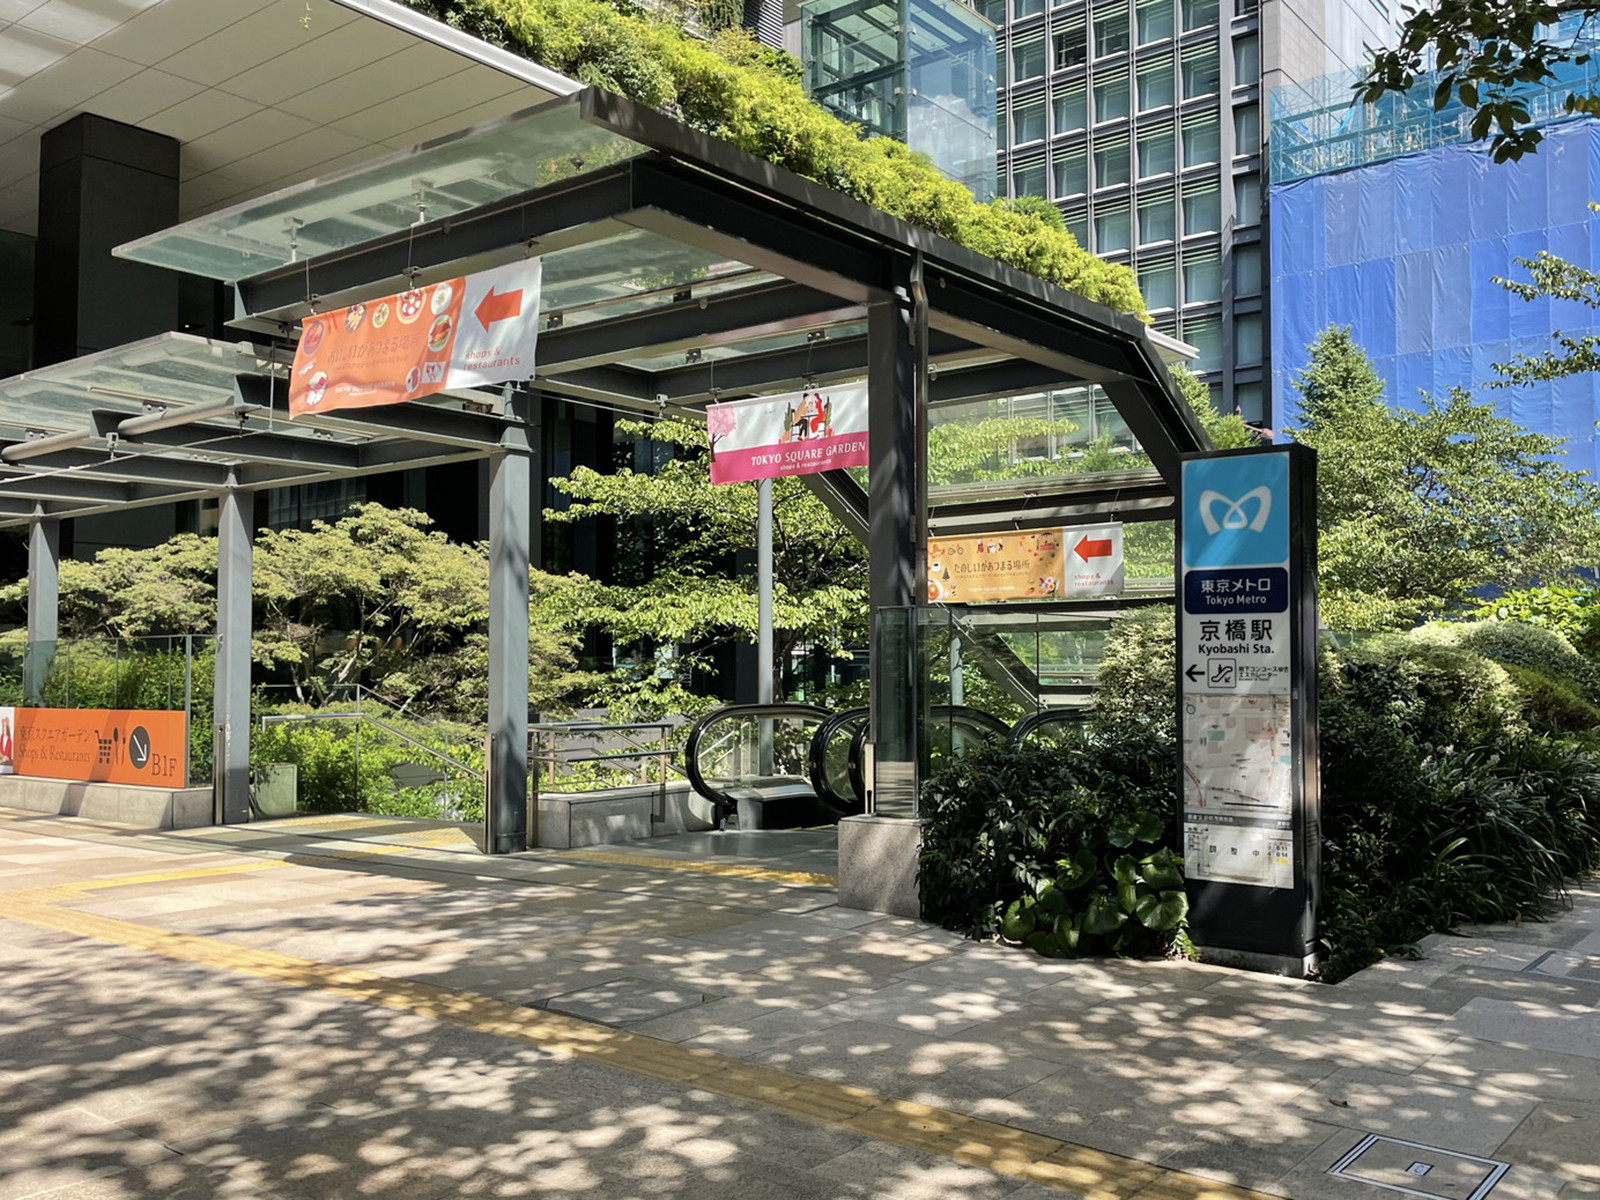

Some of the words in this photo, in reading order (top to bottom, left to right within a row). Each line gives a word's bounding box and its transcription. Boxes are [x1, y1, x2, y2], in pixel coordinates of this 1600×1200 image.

[464, 350, 491, 360] shops
[463, 357, 520, 371] restaurants
[751, 454, 782, 466] TOKYO
[785, 449, 823, 463] SQUARE
[826, 441, 866, 457] GARDEN
[780, 463, 795, 471] shops
[1201, 578, 1271, 593] 東京メトロ
[1205, 595, 1234, 606] Tokyo
[1236, 595, 1267, 605] Metro
[1200, 619, 1273, 641] 京橋駅
[1198, 644, 1249, 656] Kyobashi
[1253, 644, 1274, 654] Sta.
[19, 726, 91, 742] 東京スクエアガーデン
[18, 743, 38, 763] Shops
[40, 747, 48, 760] &
[50, 746, 91, 762] Restaurants
[152, 753, 177, 777] B1F
